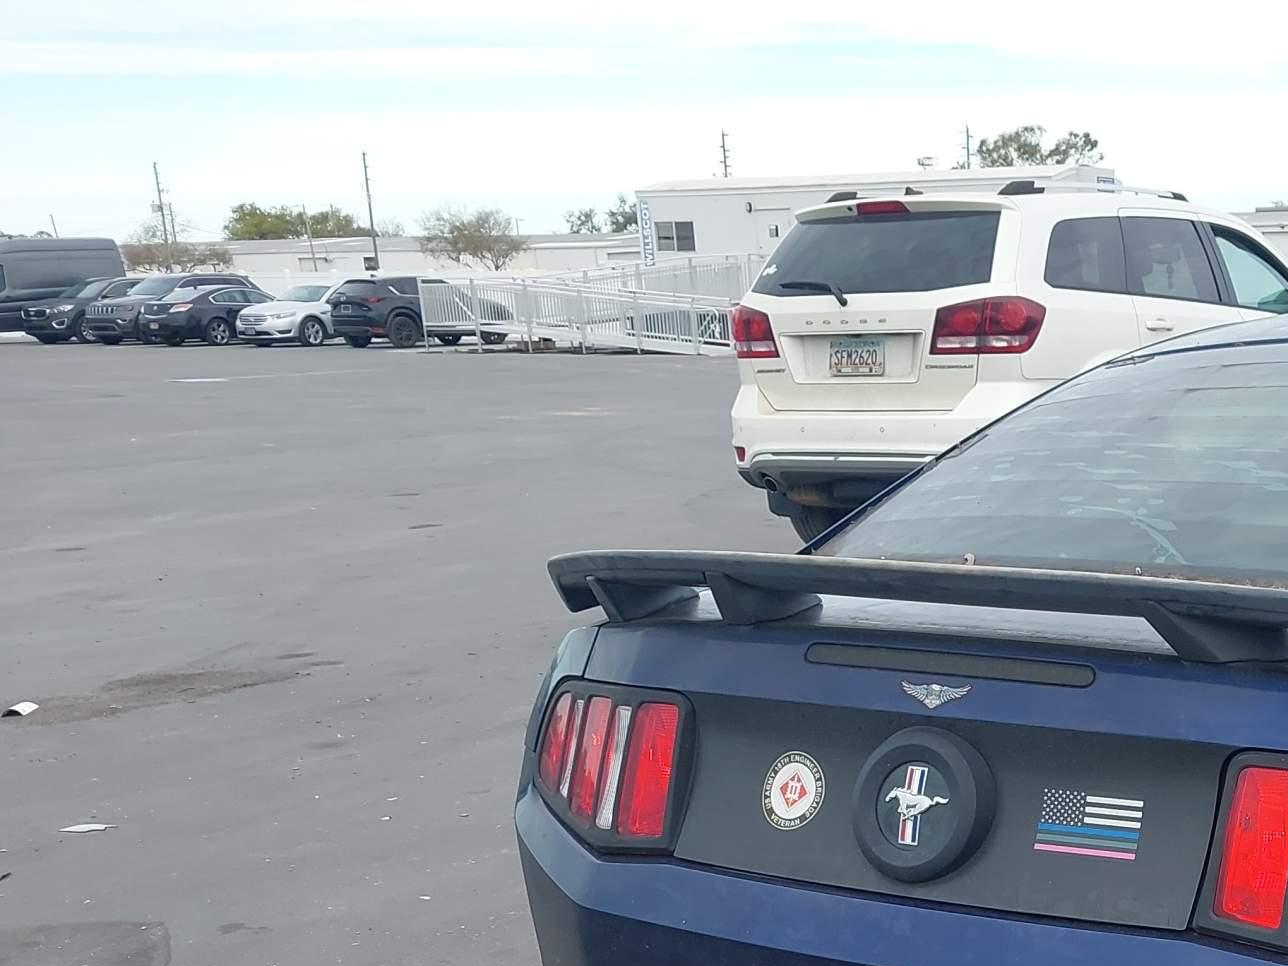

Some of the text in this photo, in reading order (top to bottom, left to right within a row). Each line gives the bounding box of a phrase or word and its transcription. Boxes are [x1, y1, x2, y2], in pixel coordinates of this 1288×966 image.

[641, 202, 654, 266] WILLSCOT
[764, 754, 822, 818] US ARMY 18TH ENGINEER BRIGADE
[770, 812, 801, 827] VETERAN
